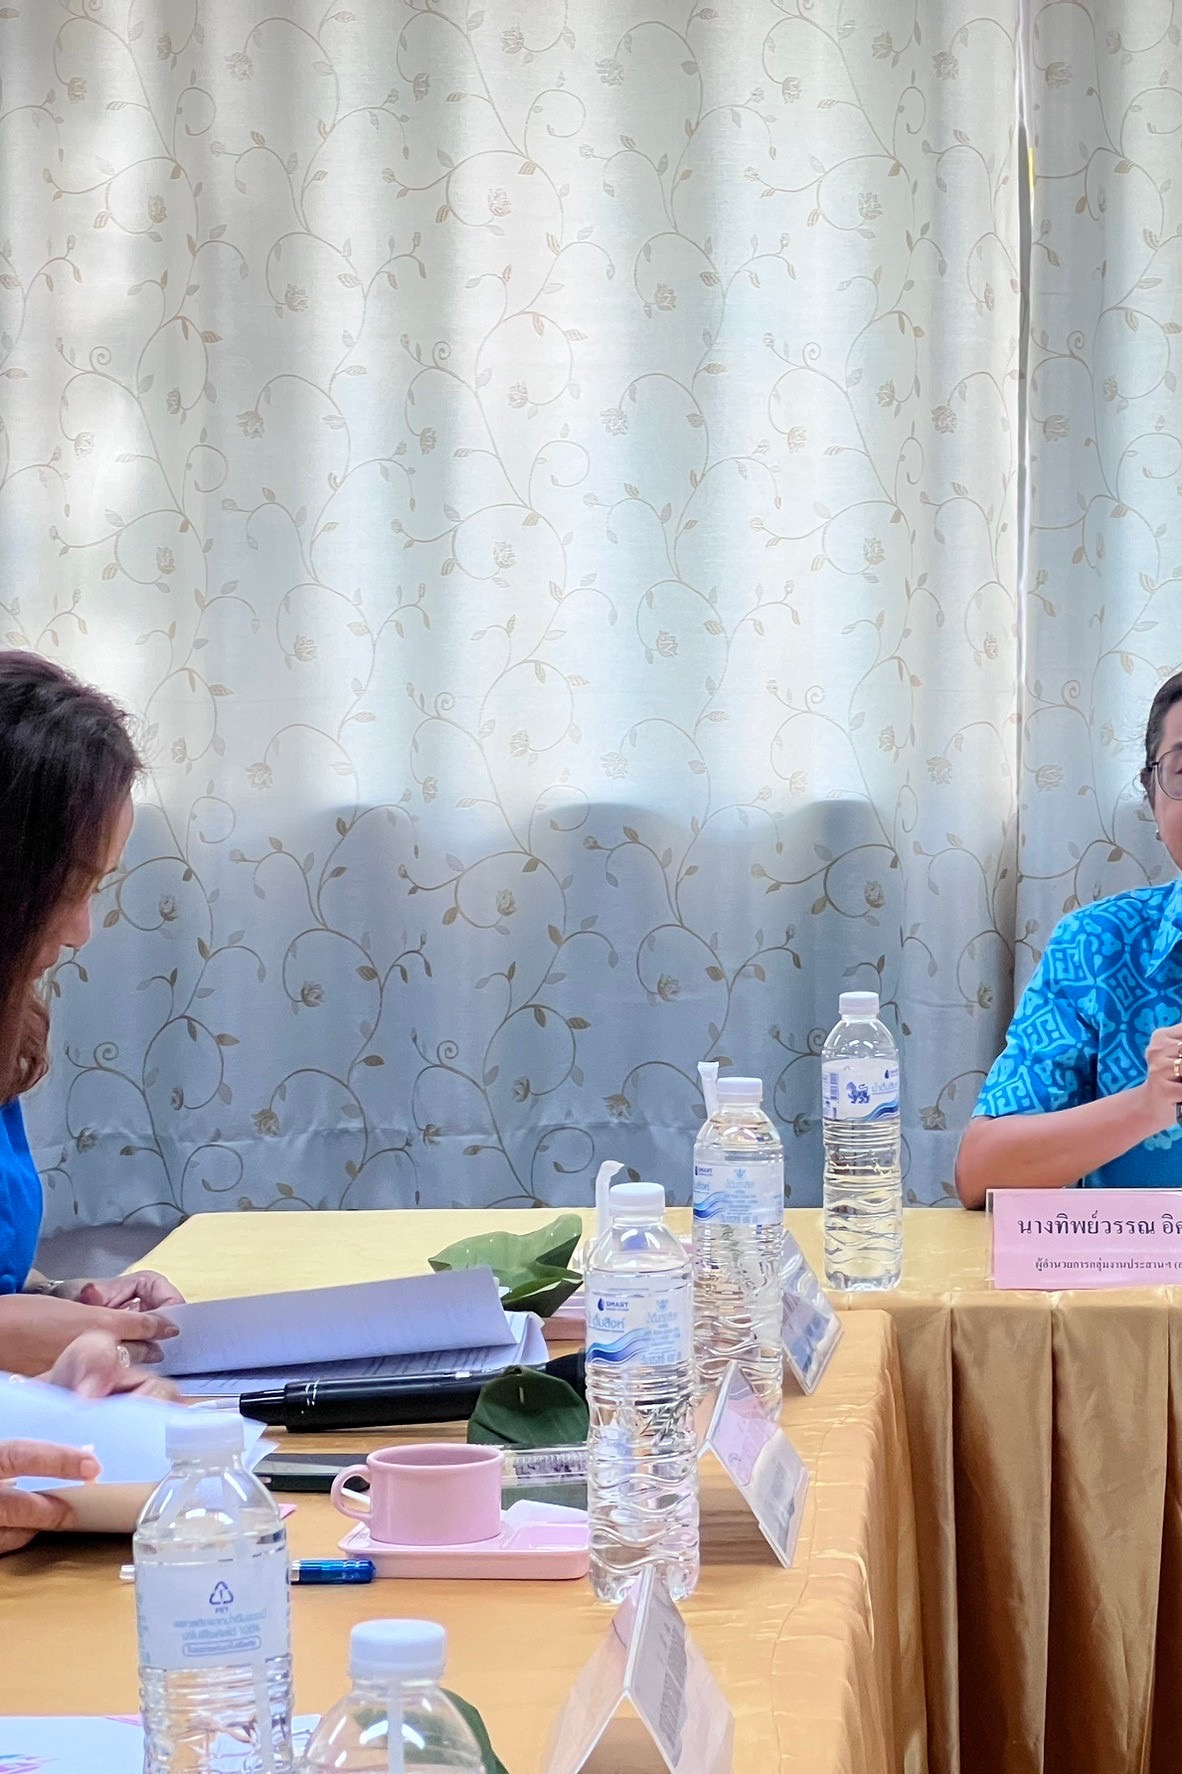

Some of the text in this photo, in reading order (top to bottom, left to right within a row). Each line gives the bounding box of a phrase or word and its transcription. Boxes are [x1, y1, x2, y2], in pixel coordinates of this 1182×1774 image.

[1018, 1210, 1155, 1235] นางทิพย์วรรณ
